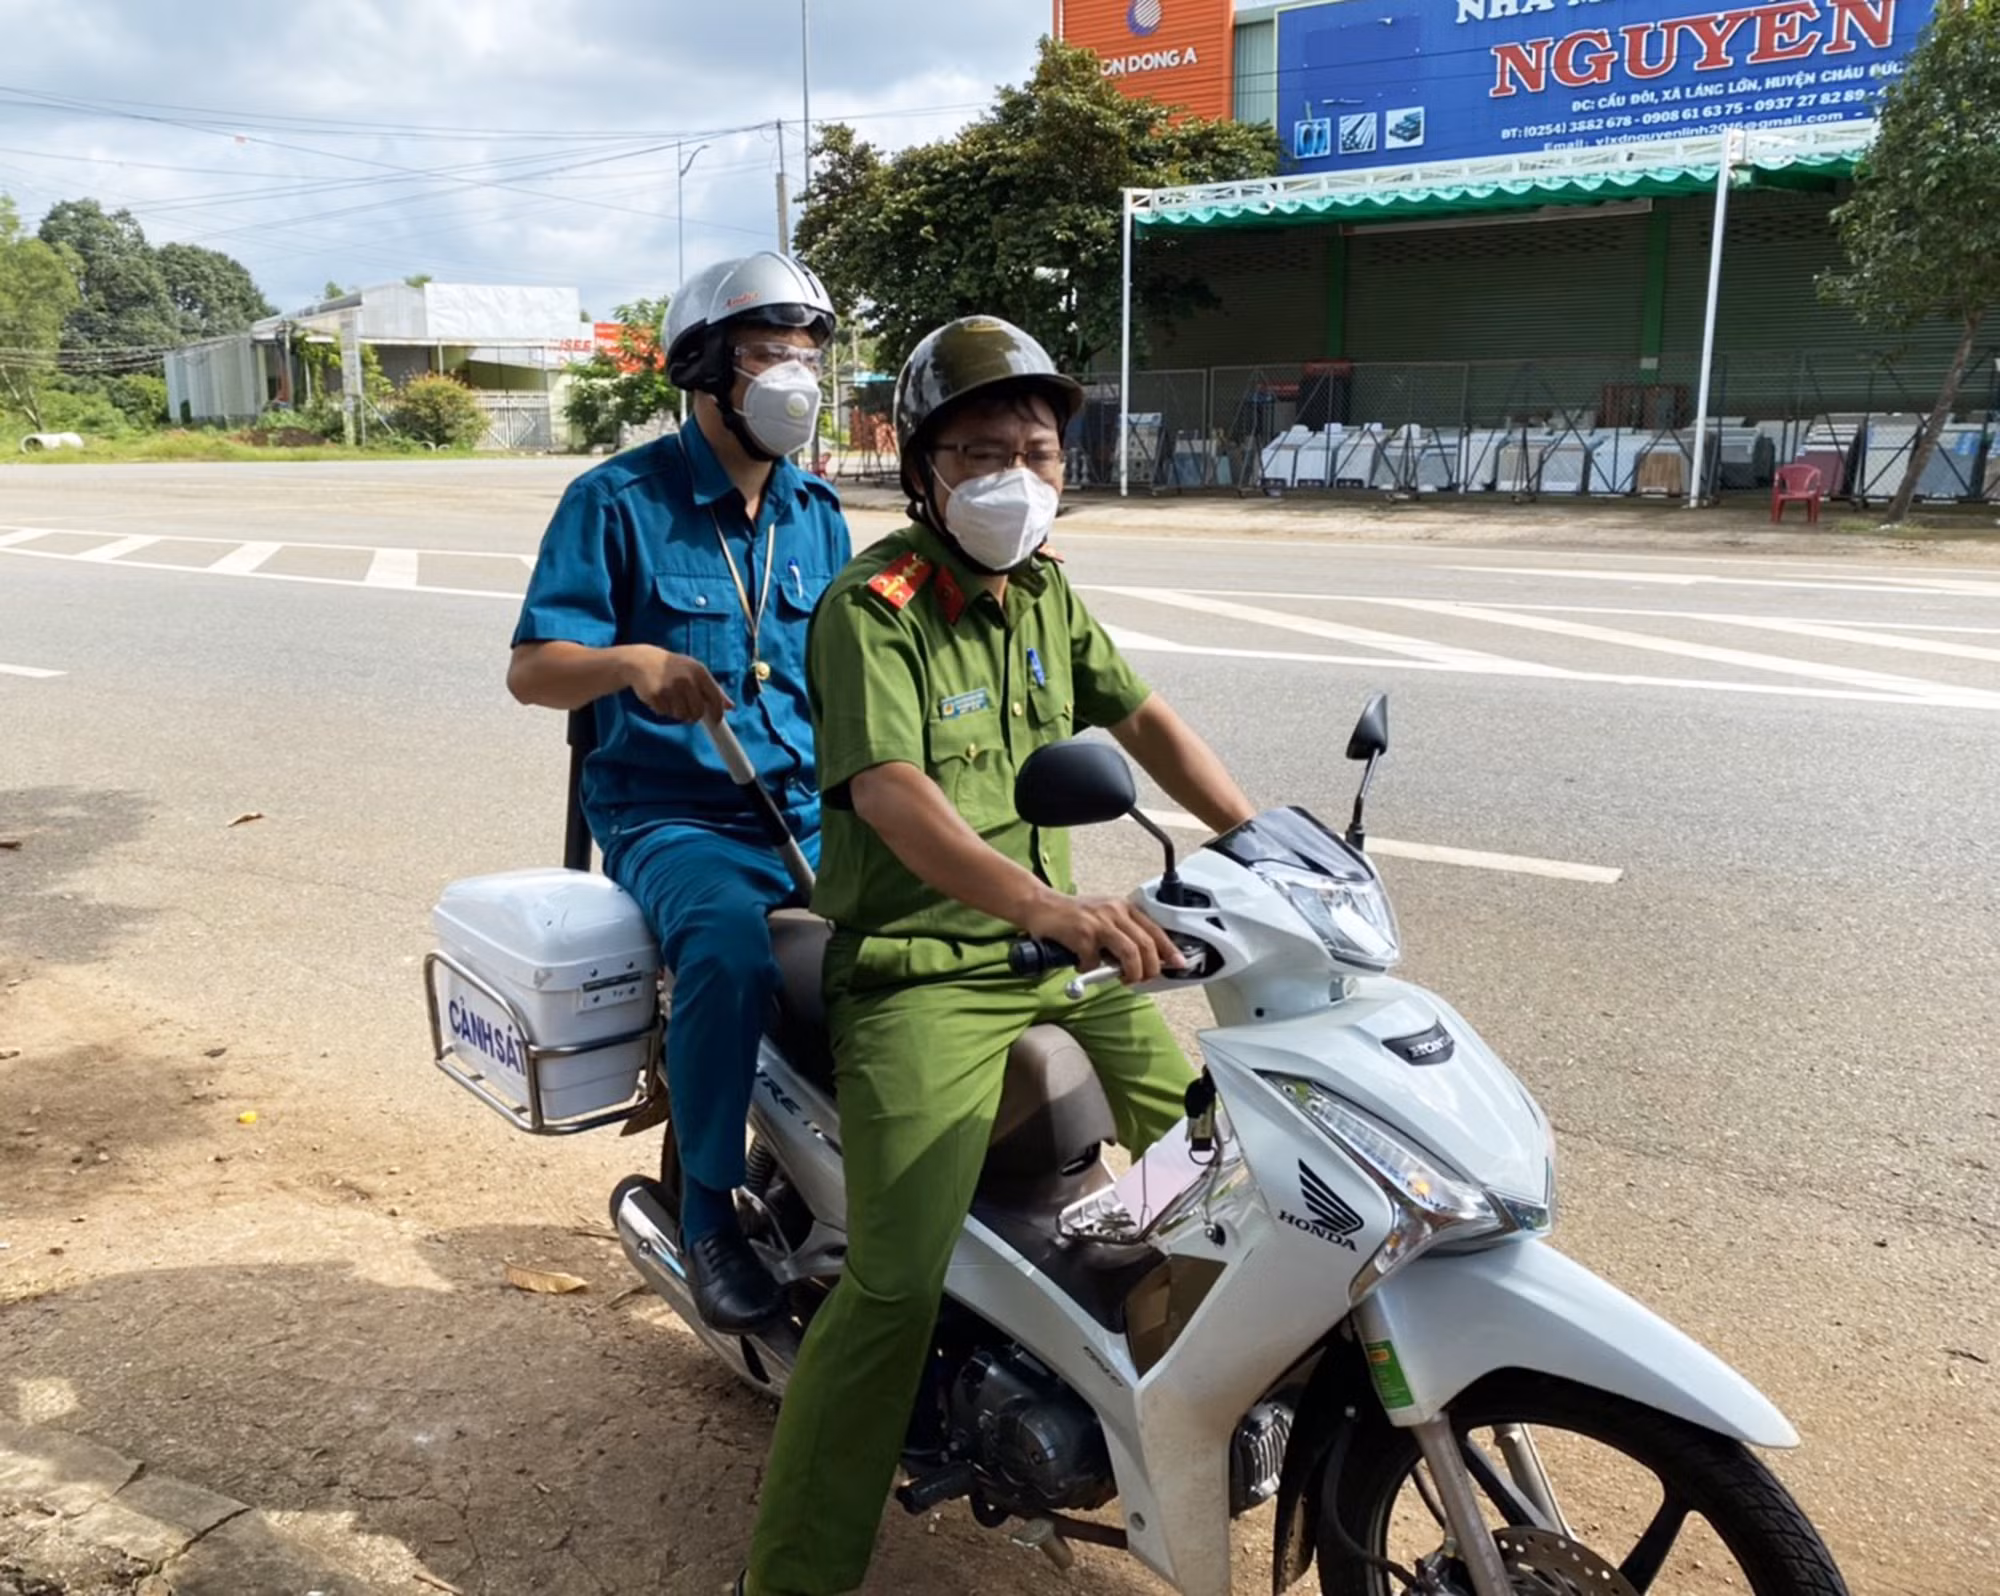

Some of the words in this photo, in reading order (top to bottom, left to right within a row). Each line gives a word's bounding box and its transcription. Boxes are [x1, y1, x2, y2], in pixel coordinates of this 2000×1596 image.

[1127, 50, 1180, 73] DONG
[1183, 47, 1198, 65] A
[1606, 115, 1632, 129] 678
[1642, 109, 1680, 125] 0908
[1681, 107, 1700, 121] 61
[1702, 104, 1722, 118] 63
[1724, 101, 1744, 116] 75
[1754, 96, 1794, 112] 0937
[1797, 93, 1818, 108] 27
[1819, 90, 1842, 105] 82
[1843, 88, 1865, 102] 89
[1277, 1210, 1358, 1253] HONDA
